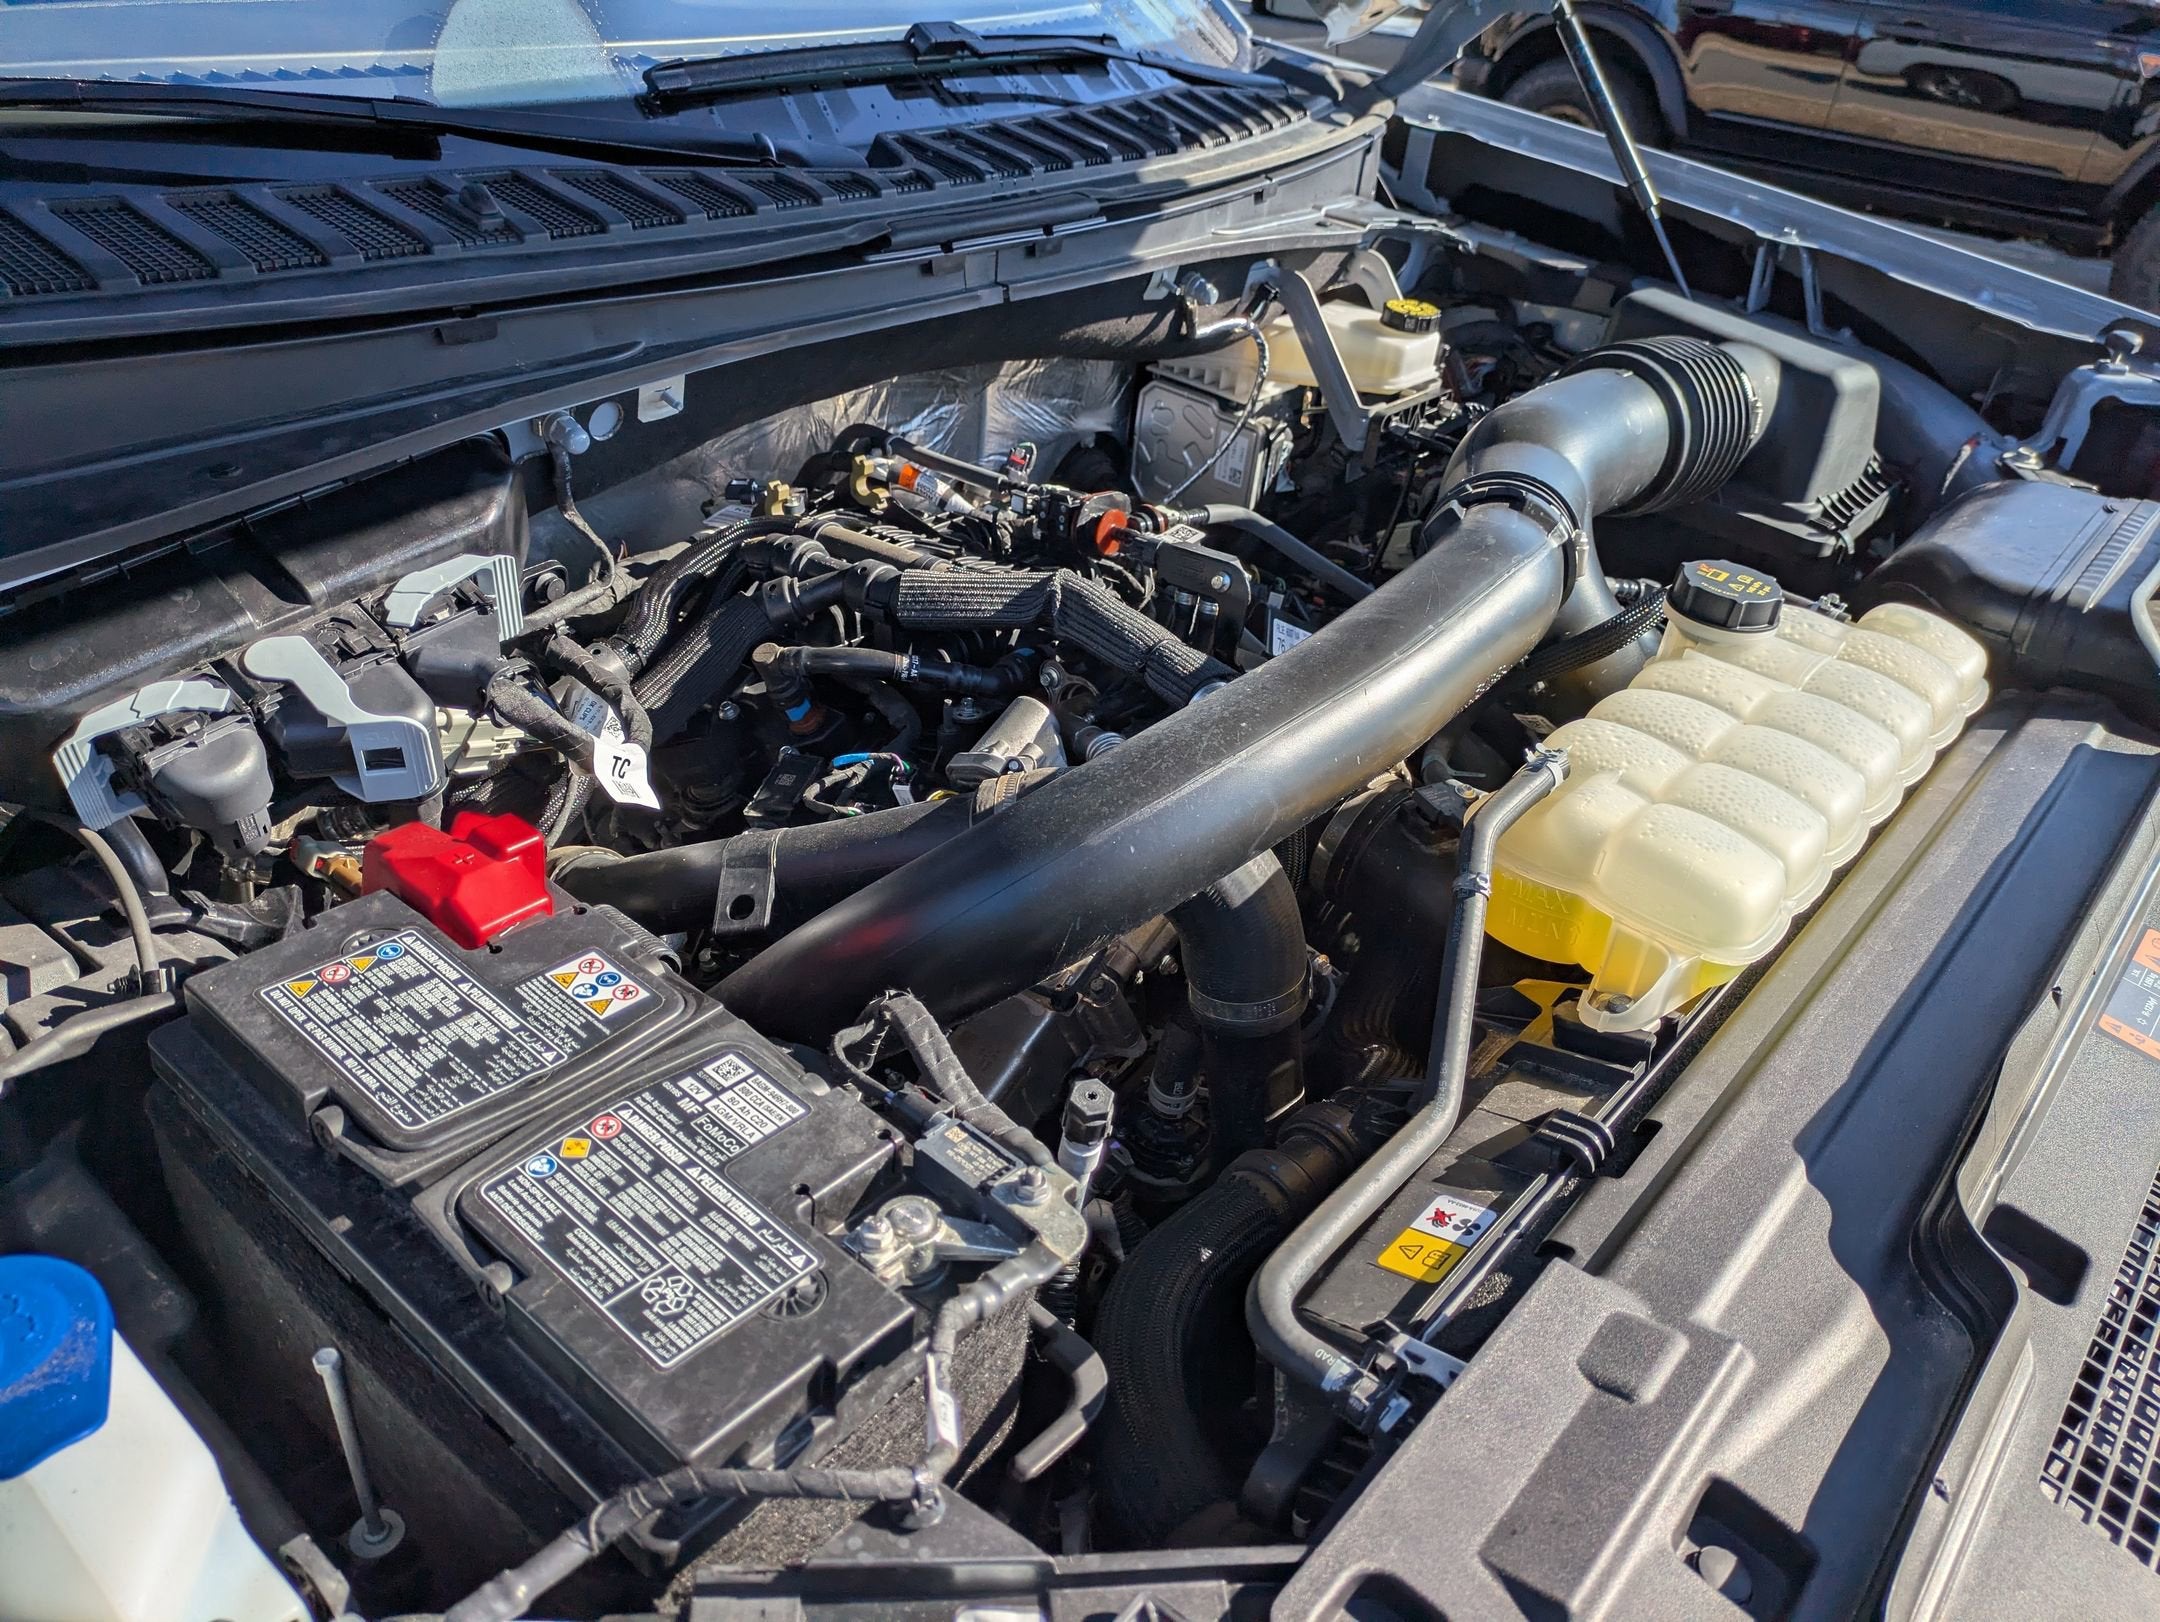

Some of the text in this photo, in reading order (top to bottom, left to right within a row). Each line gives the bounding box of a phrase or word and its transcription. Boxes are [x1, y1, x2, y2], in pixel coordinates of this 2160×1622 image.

[612, 756, 631, 779] TC
[1513, 879, 1569, 914] MAX
[1507, 904, 1564, 941] MIN
[407, 939, 463, 981] DANGER/POISON
[464, 986, 522, 1030] PELIGRO/VENENO
[267, 989, 385, 1092] DO NOT OPEN. NE PAS OUVRIR. NO LA ABRA.
[674, 1096, 704, 1116] MF
[684, 1082, 705, 1096] 12V
[747, 1093, 768, 1107] CCA
[707, 1102, 759, 1140] AGM/VRLA
[725, 1095, 770, 1129] 80 Ah C20
[693, 1116, 744, 1154] FoMoCo
[624, 1114, 689, 1166] DANGER/POISON
[694, 1171, 763, 1227] PELIGRO/VENENO
[494, 1183, 545, 1229] Batterie au plomb
[504, 1178, 555, 1224] Lead Acid Battery
[514, 1173, 563, 1216] NON-SPILLABLE
[571, 1226, 601, 1252] CONTRA
[595, 1248, 634, 1283] DERRAMES
[1314, 1348, 1335, 1366] RAD
